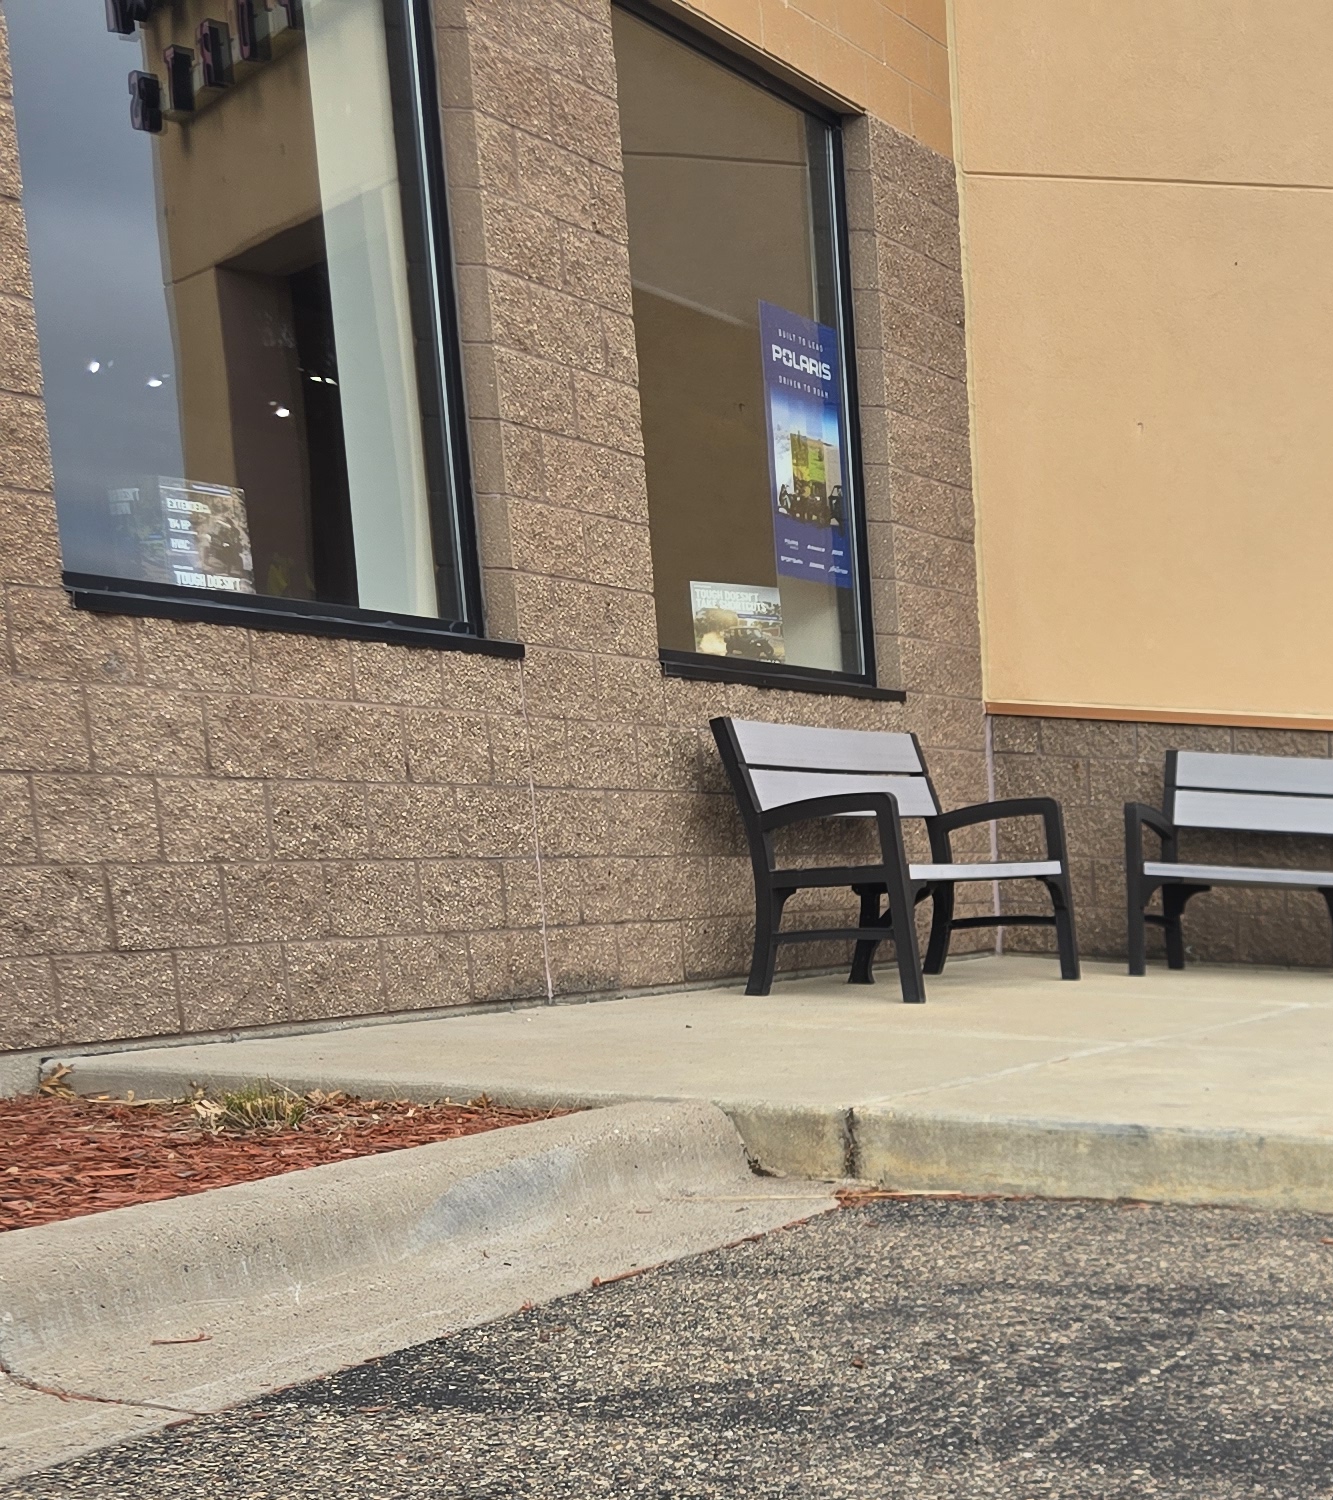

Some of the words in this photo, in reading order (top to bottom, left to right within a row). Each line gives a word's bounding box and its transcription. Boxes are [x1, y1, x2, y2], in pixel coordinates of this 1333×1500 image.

[771, 343, 831, 380] POLARIS
[694, 588, 722, 600] TOUGH
[724, 590, 758, 602] DOESN'T
